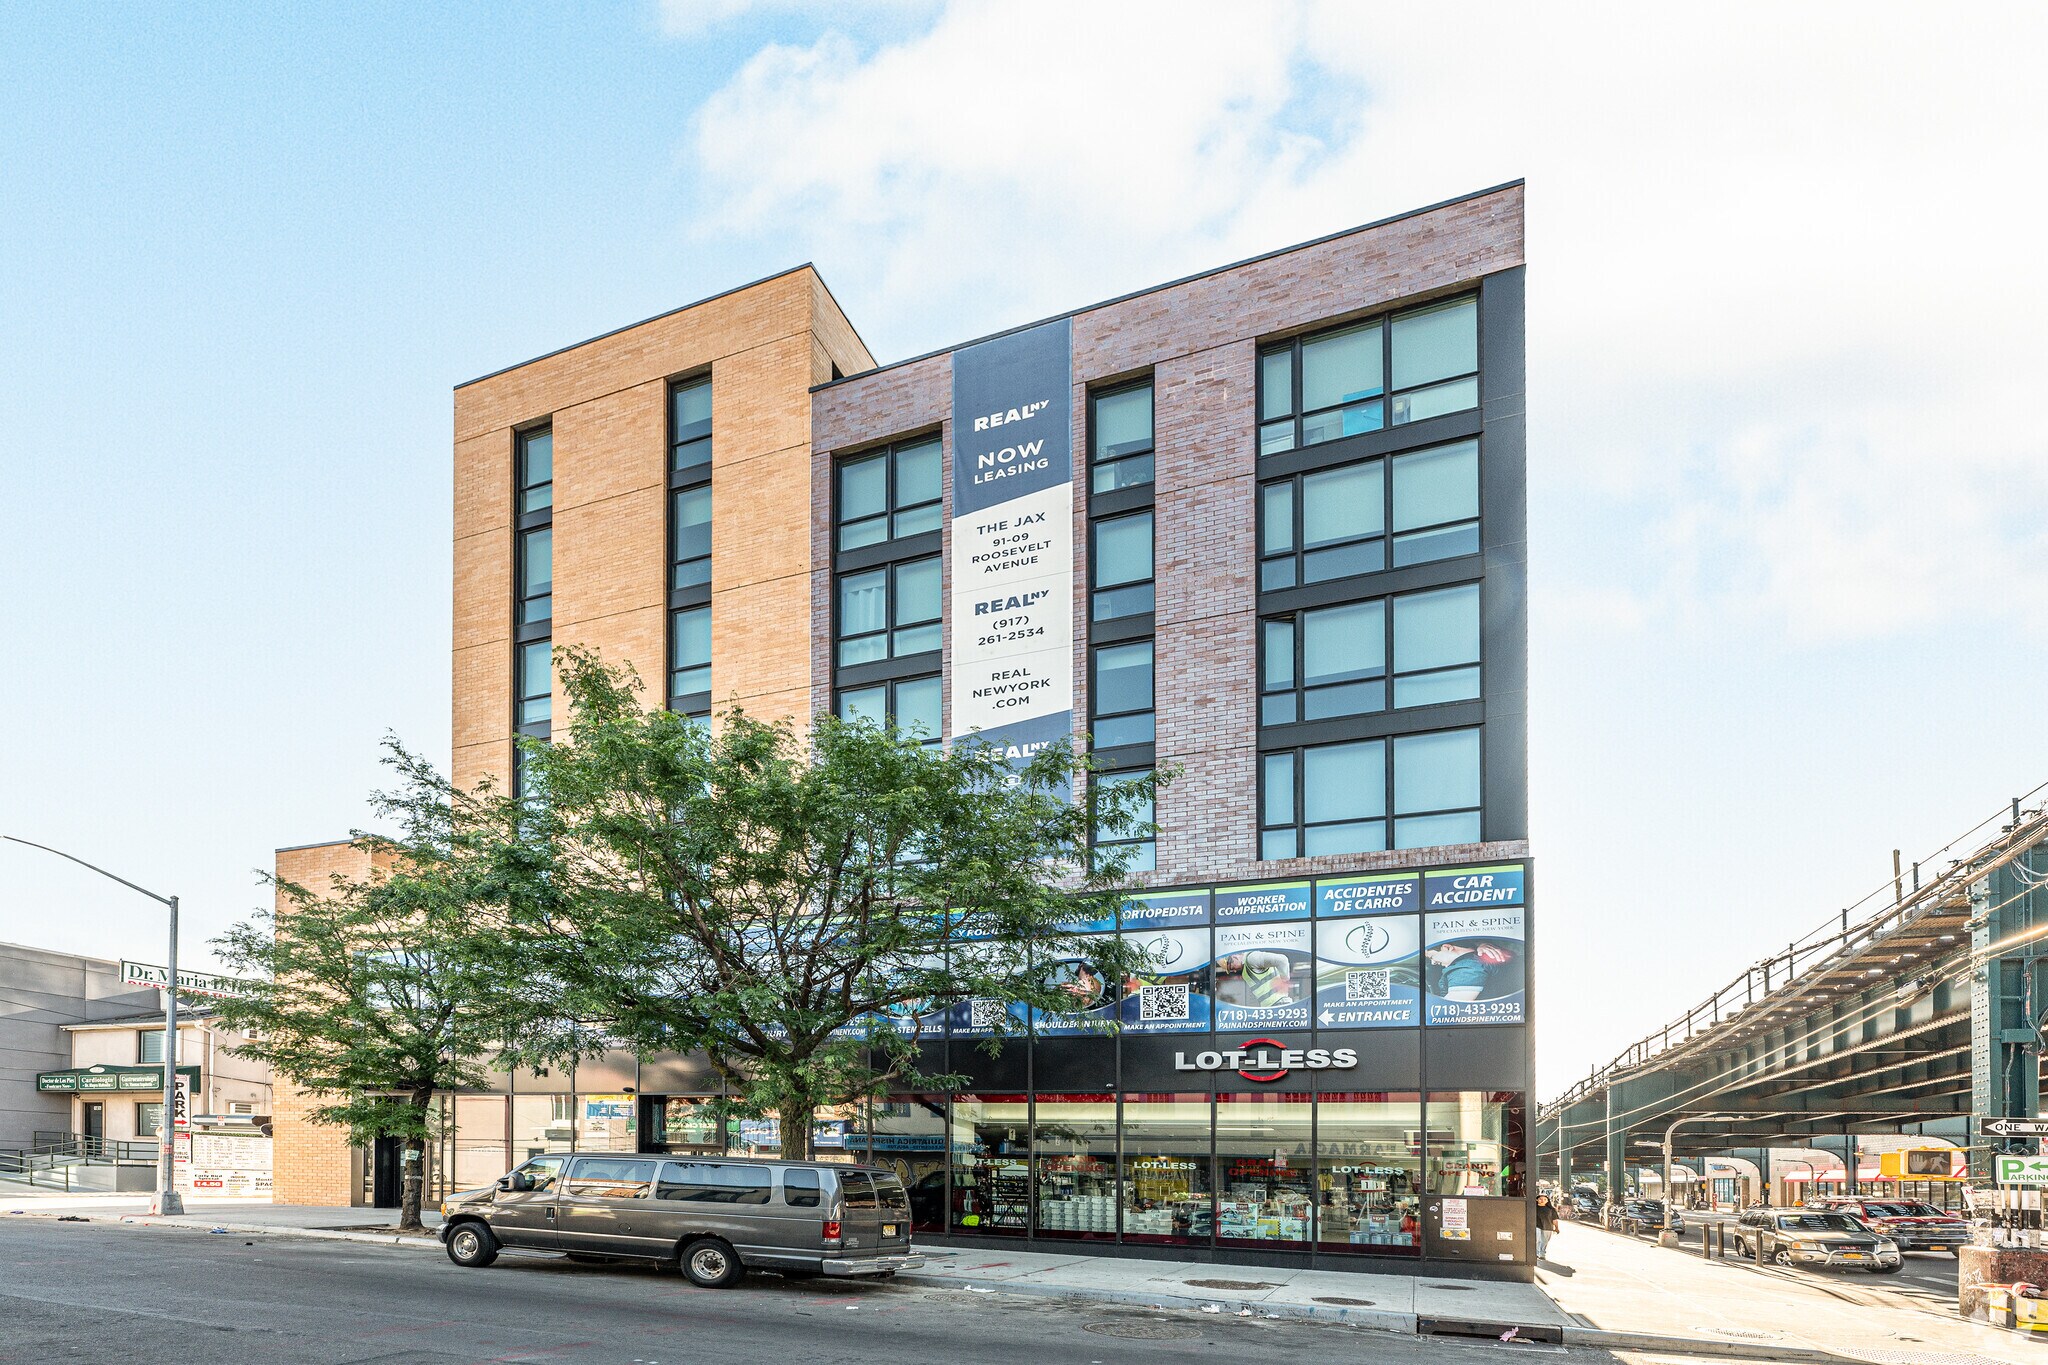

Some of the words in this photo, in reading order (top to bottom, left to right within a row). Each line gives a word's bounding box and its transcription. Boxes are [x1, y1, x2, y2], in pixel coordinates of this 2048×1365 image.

[978, 439, 1044, 469] NOW
[974, 458, 1049, 485] LEASING
[976, 520, 1009, 536] THE
[1014, 512, 1046, 528] JAX
[993, 533, 1029, 547] 91-09
[972, 540, 1052, 564] ROOSEVELT
[984, 555, 1039, 573] AVENUE
[993, 615, 1030, 631] (917)
[978, 626, 1045, 646] 261-2534
[991, 668, 1031, 681] REAL
[972, 678, 1051, 698] NEWYORK
[992, 696, 1030, 709] .COM
[1453, 875, 1494, 889] CAR
[1324, 883, 1412, 900] ACCIDENTES
[1431, 887, 1517, 905] ACCIDENT
[1238, 894, 1286, 906] WORKER
[1333, 901, 1353, 911] DE
[1355, 897, 1403, 910] CARRO
[1122, 905, 1203, 920] ORTOPEDISTA
[1218, 902, 1307, 916] COMPENSATION
[1432, 920, 1464, 929] PAIN
[1482, 916, 1521, 927] SPINE
[1221, 933, 1251, 942] PAIN
[1255, 932, 1264, 940] &
[1268, 929, 1306, 938] SPINE
[129, 965, 154, 981] Dr.
[1218, 1008, 1308, 1022] (718)-433-9293
[1338, 1010, 1411, 1022] ENTRANCE
[1430, 1003, 1521, 1017] (718)-433-9293
[1218, 1020, 1308, 1029] PAINANDSPINENY.COM
[1431, 1014, 1521, 1024] PAINANDSPINENY.COM
[920, 1025, 942, 1033] CELLS
[1175, 1048, 1358, 1070] LOT-LESS
[175, 1082, 186, 1118] PARK
[1134, 1161, 1197, 1170] LOT-LESS
[1332, 1165, 1405, 1175] LOT-LESS
[2002, 1160, 2048, 1181] PARKIN
